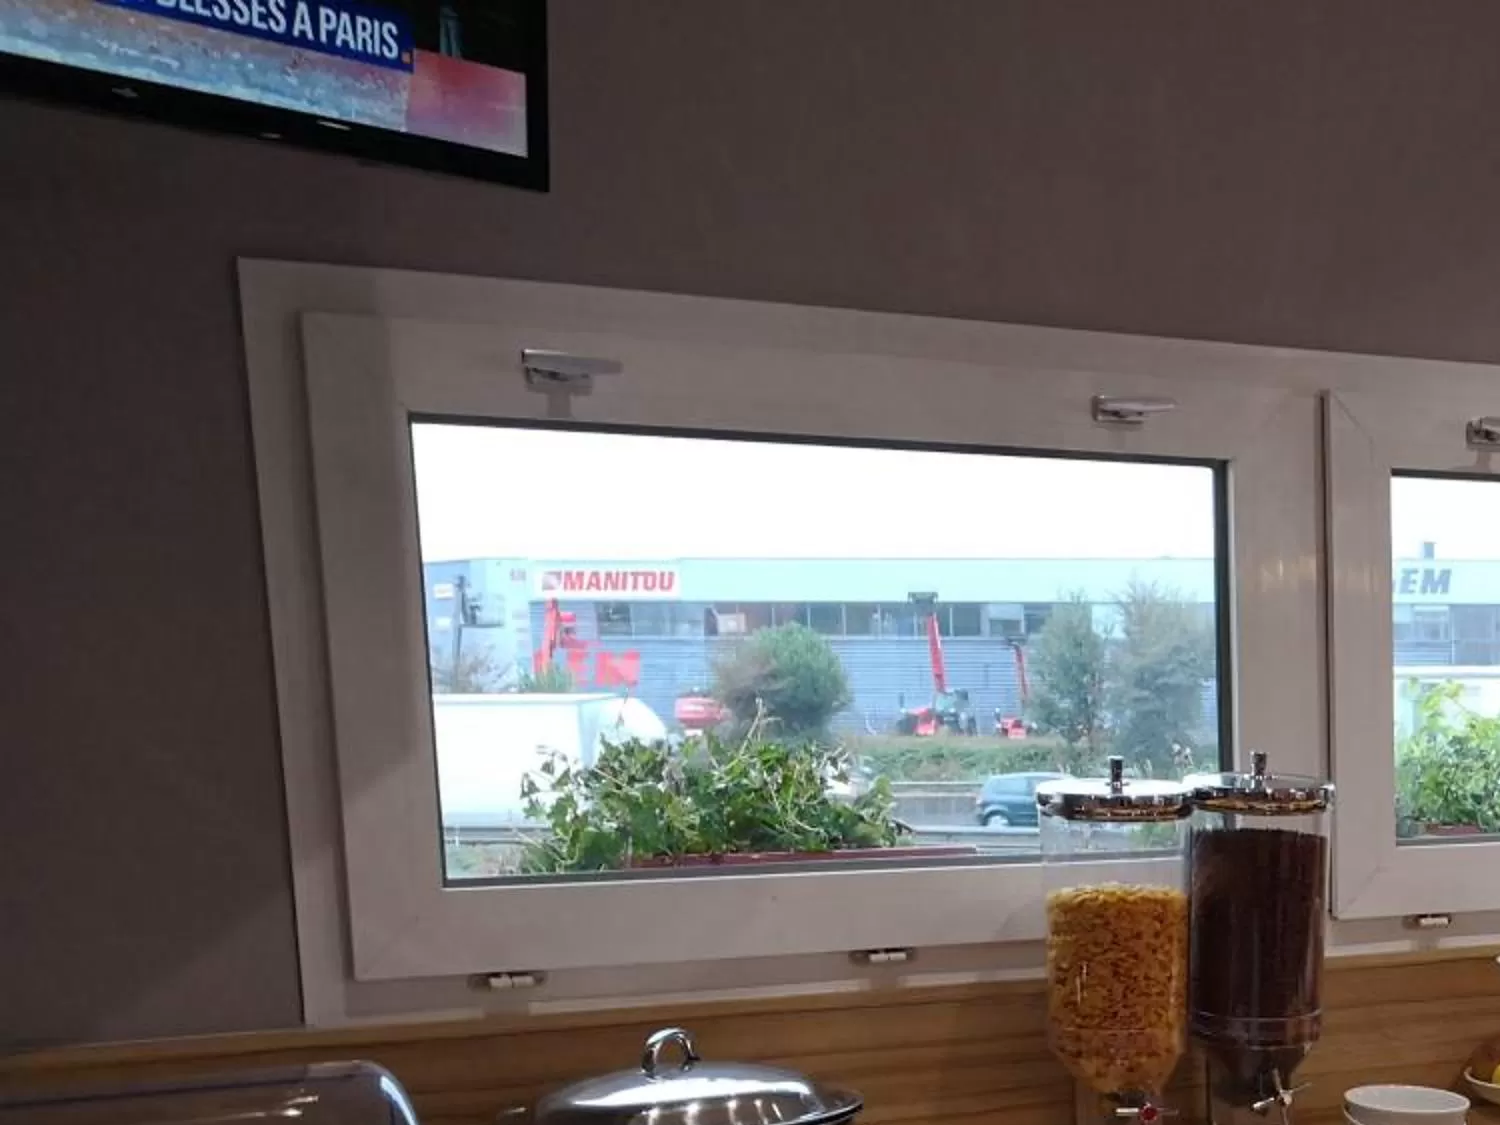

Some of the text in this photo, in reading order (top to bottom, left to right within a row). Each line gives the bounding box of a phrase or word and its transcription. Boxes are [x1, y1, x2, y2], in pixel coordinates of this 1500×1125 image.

[156, 0, 287, 33] SSES
[293, 2, 315, 41] A
[563, 570, 675, 592] MANITOU
[1392, 568, 1452, 595] EM
